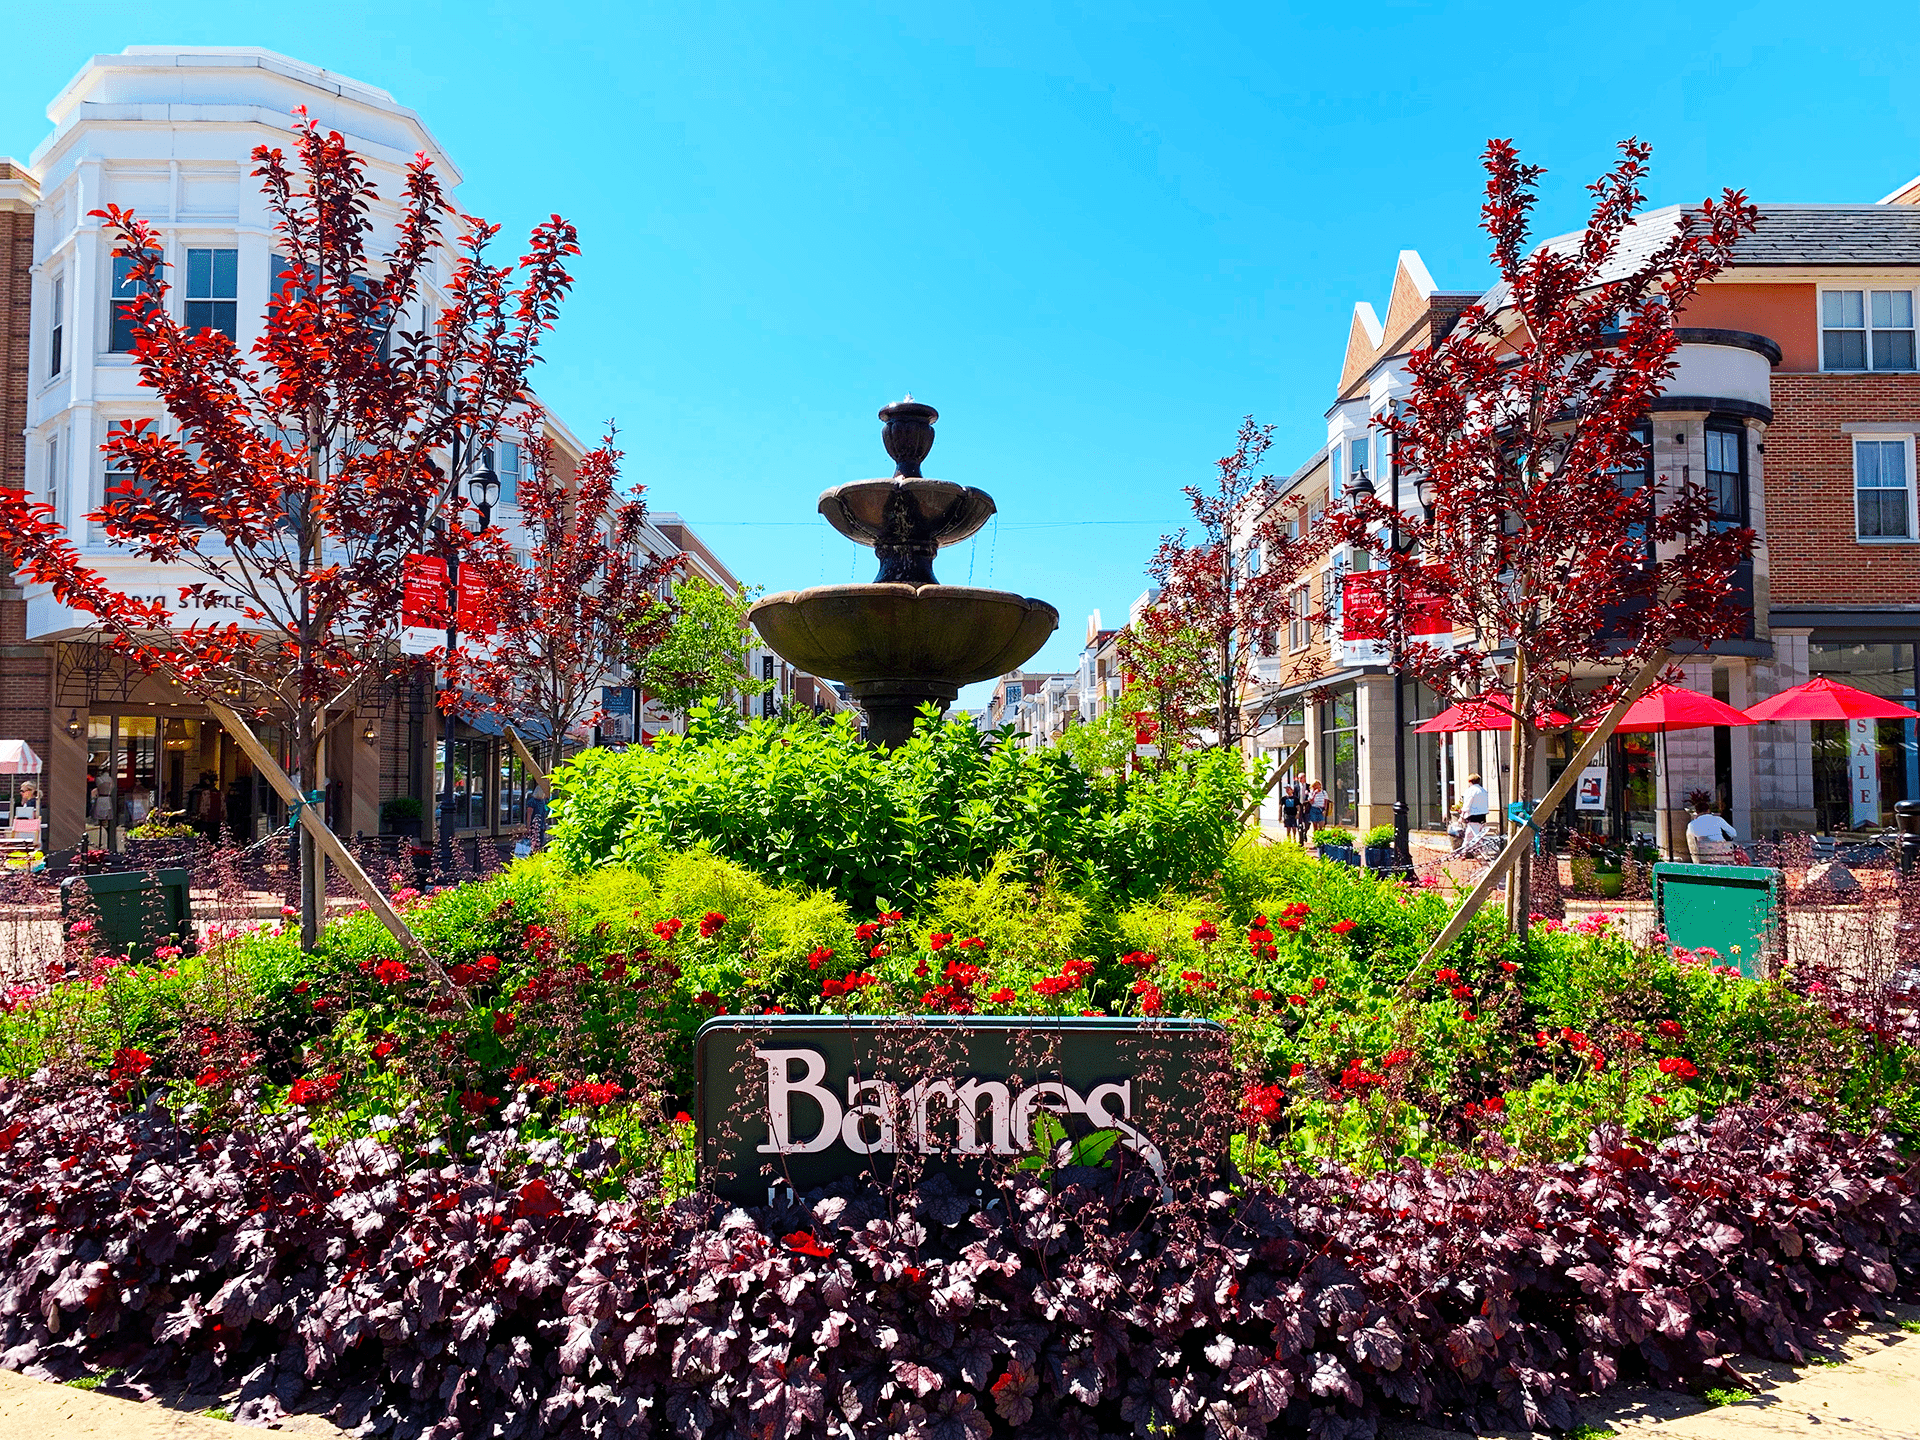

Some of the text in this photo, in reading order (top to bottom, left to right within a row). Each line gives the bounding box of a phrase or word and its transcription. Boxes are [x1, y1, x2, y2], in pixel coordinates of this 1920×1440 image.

[178, 595, 245, 609] STTE
[1857, 719, 1872, 804] SALE
[755, 1048, 1169, 1202] Barnes
